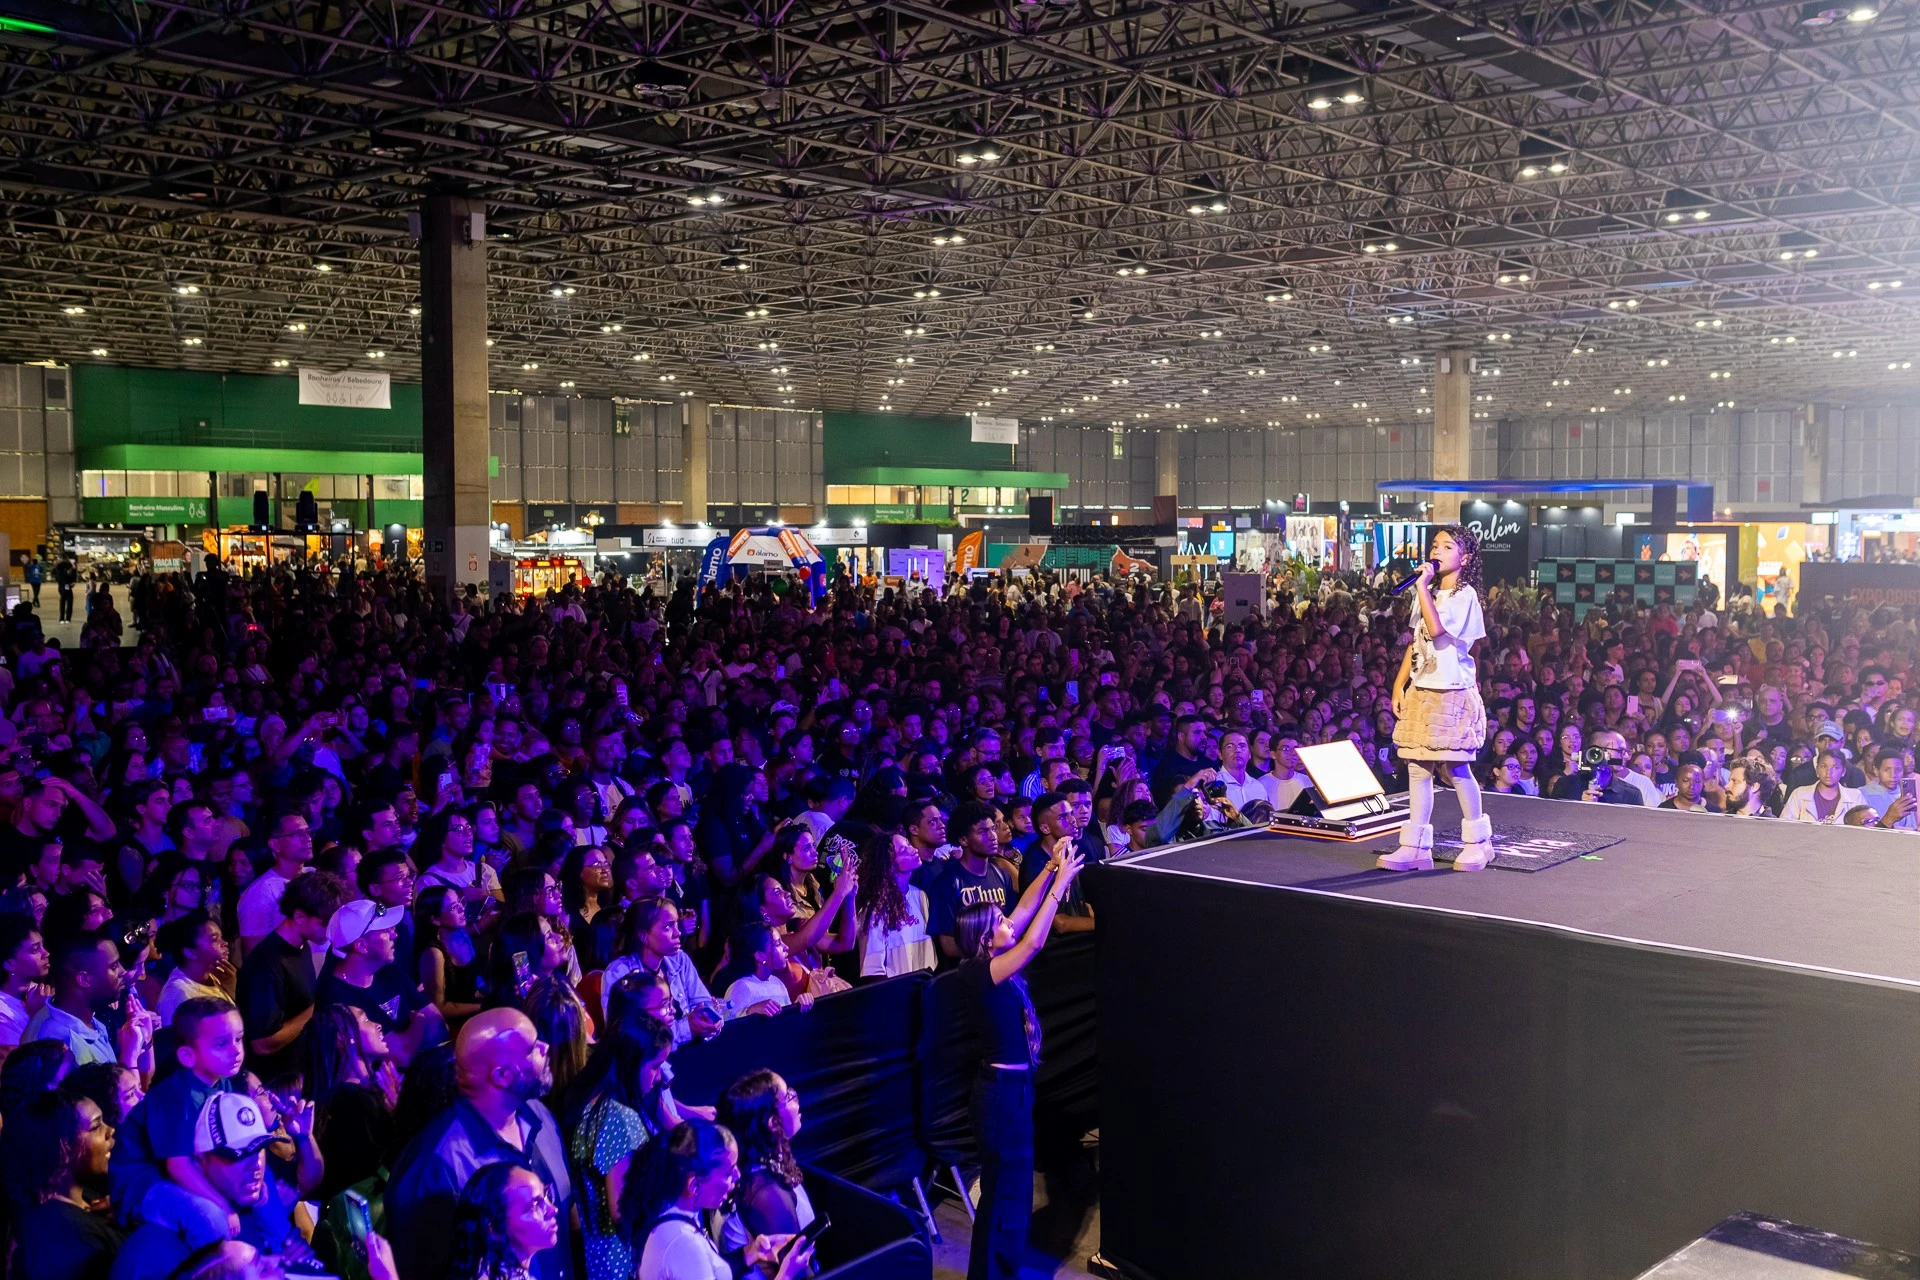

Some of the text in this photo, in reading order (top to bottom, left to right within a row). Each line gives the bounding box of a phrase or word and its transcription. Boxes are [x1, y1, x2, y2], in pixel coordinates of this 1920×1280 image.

[961, 488, 970, 503] 2
[1468, 513, 1520, 542] Belém
[755, 549, 778, 558] álamo
[960, 885, 1006, 908] Thug
